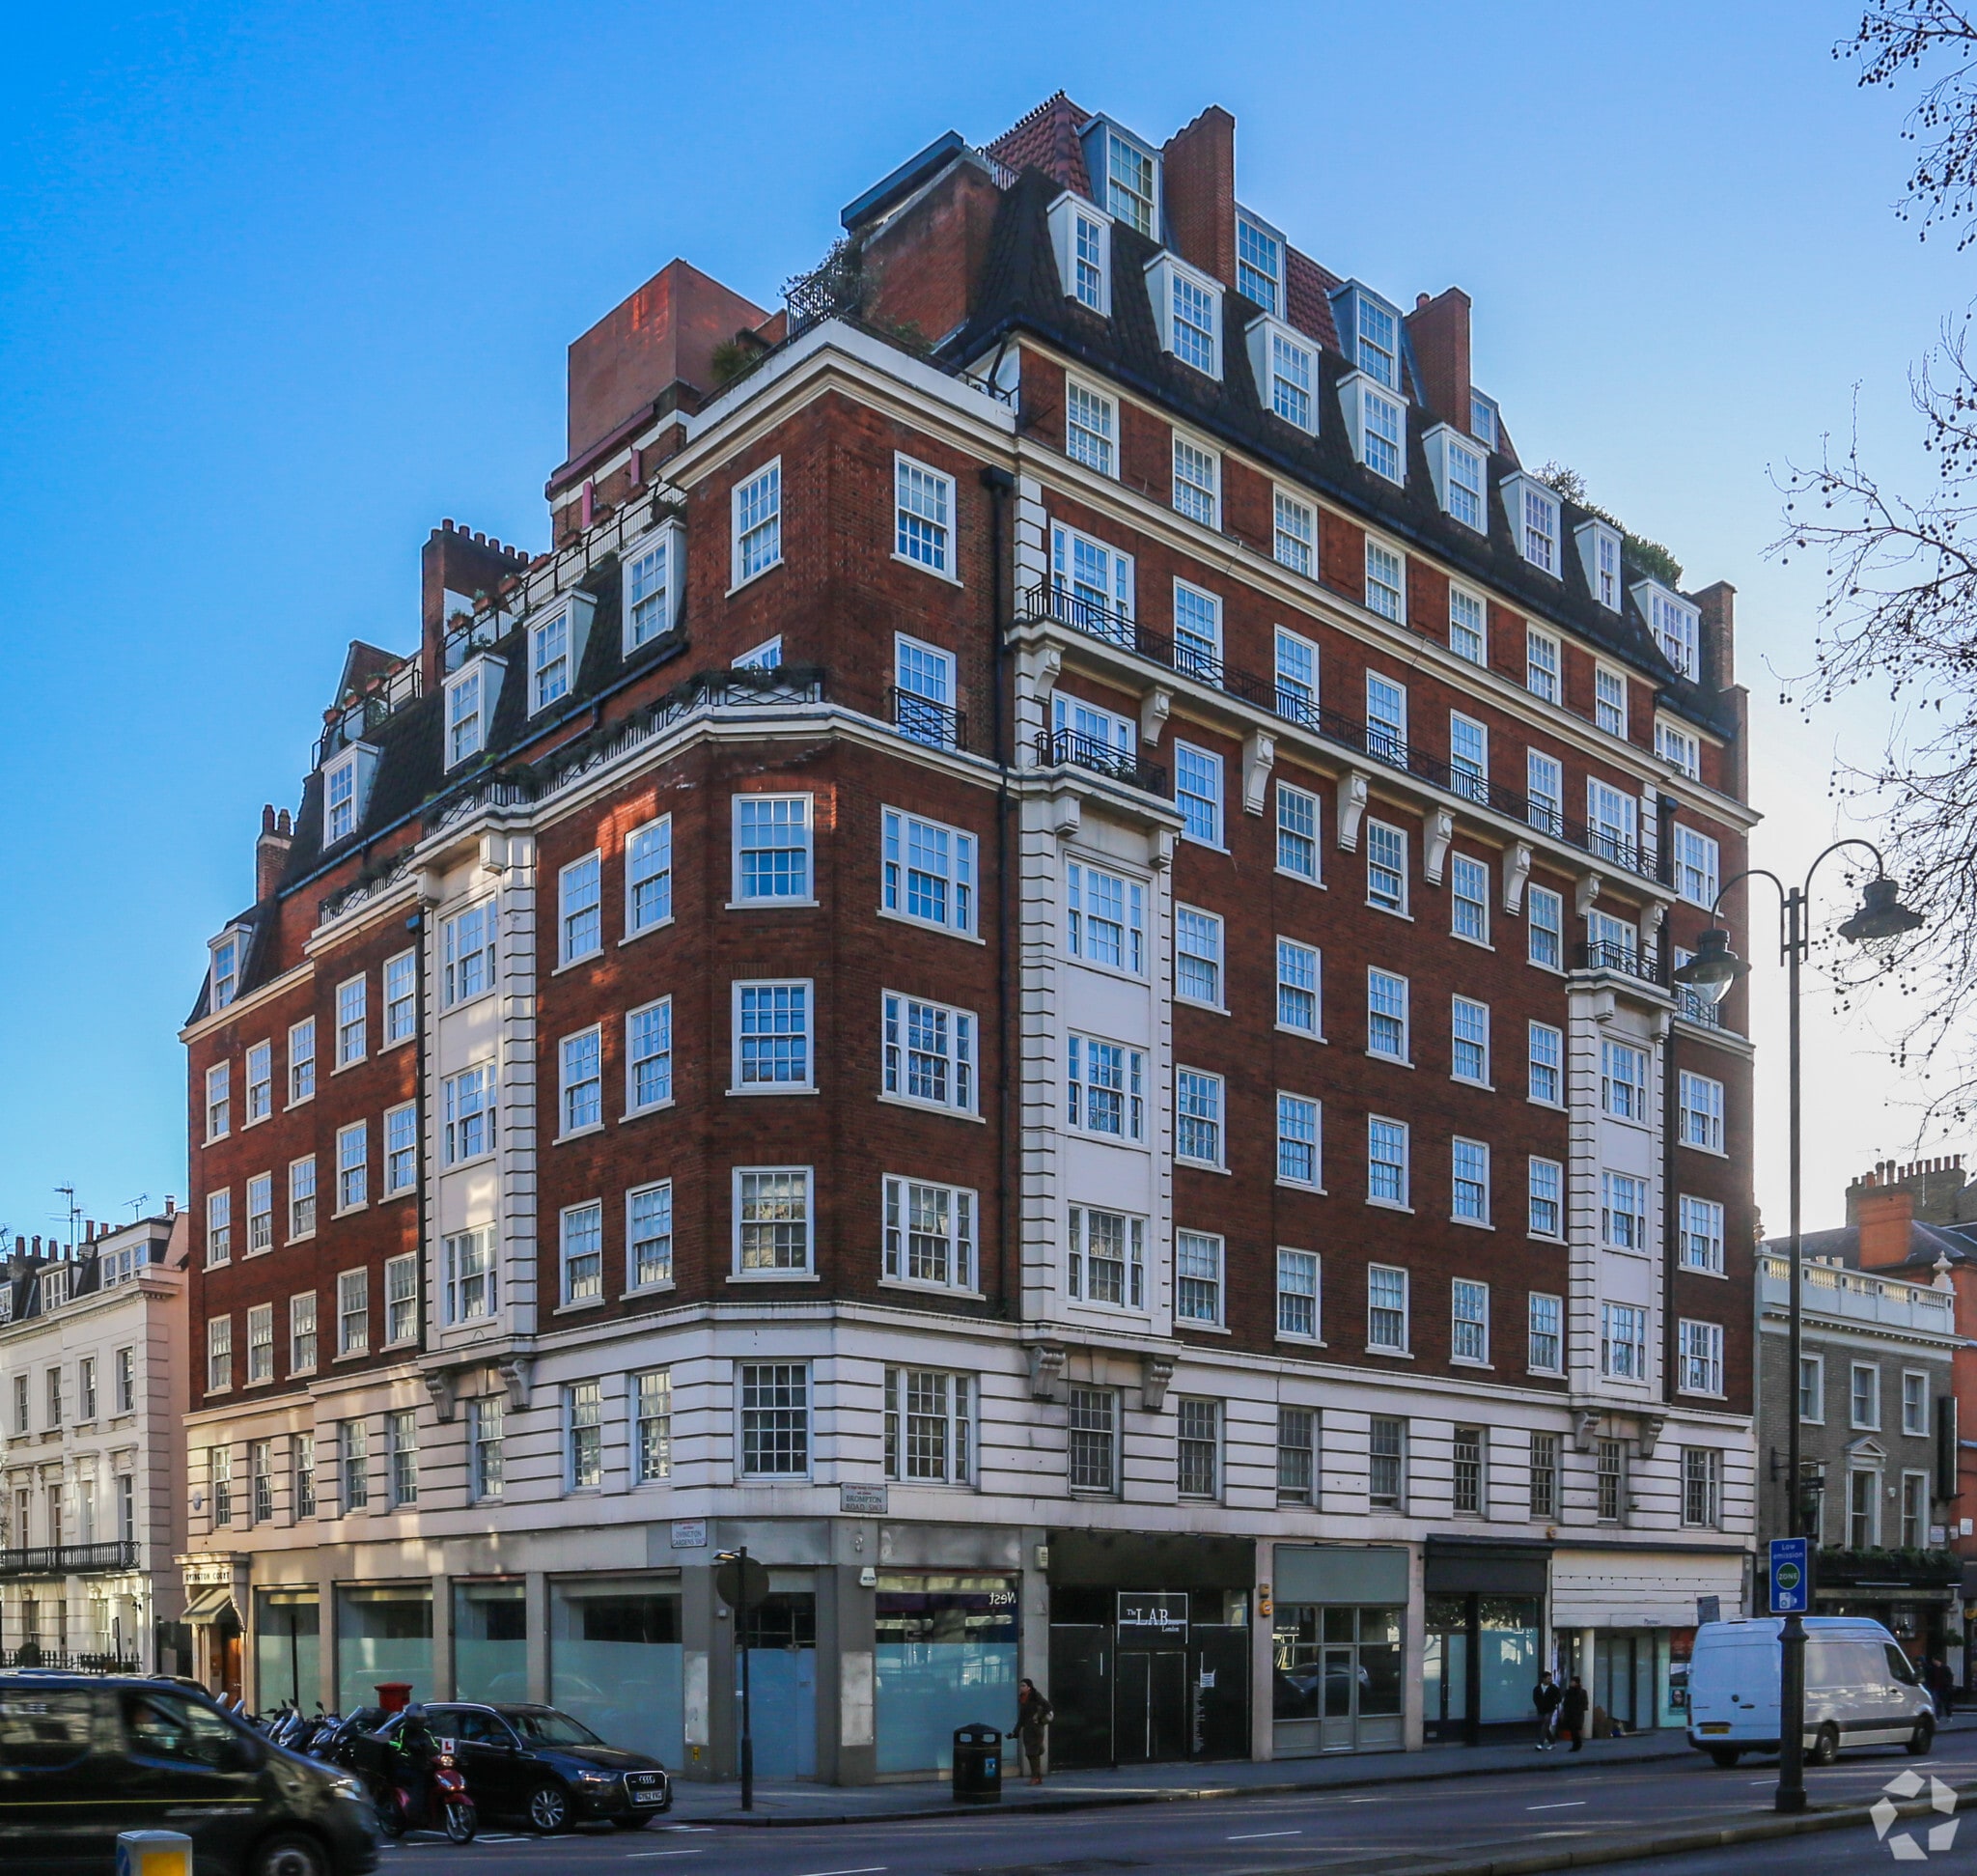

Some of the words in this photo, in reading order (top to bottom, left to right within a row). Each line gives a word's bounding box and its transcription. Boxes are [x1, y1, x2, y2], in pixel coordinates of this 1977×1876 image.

[1773, 1551, 1804, 1560] emission
[1778, 1572, 1798, 1581] ZONE
[1136, 1608, 1168, 1626] LAB
[445, 1741, 452, 1750] L
